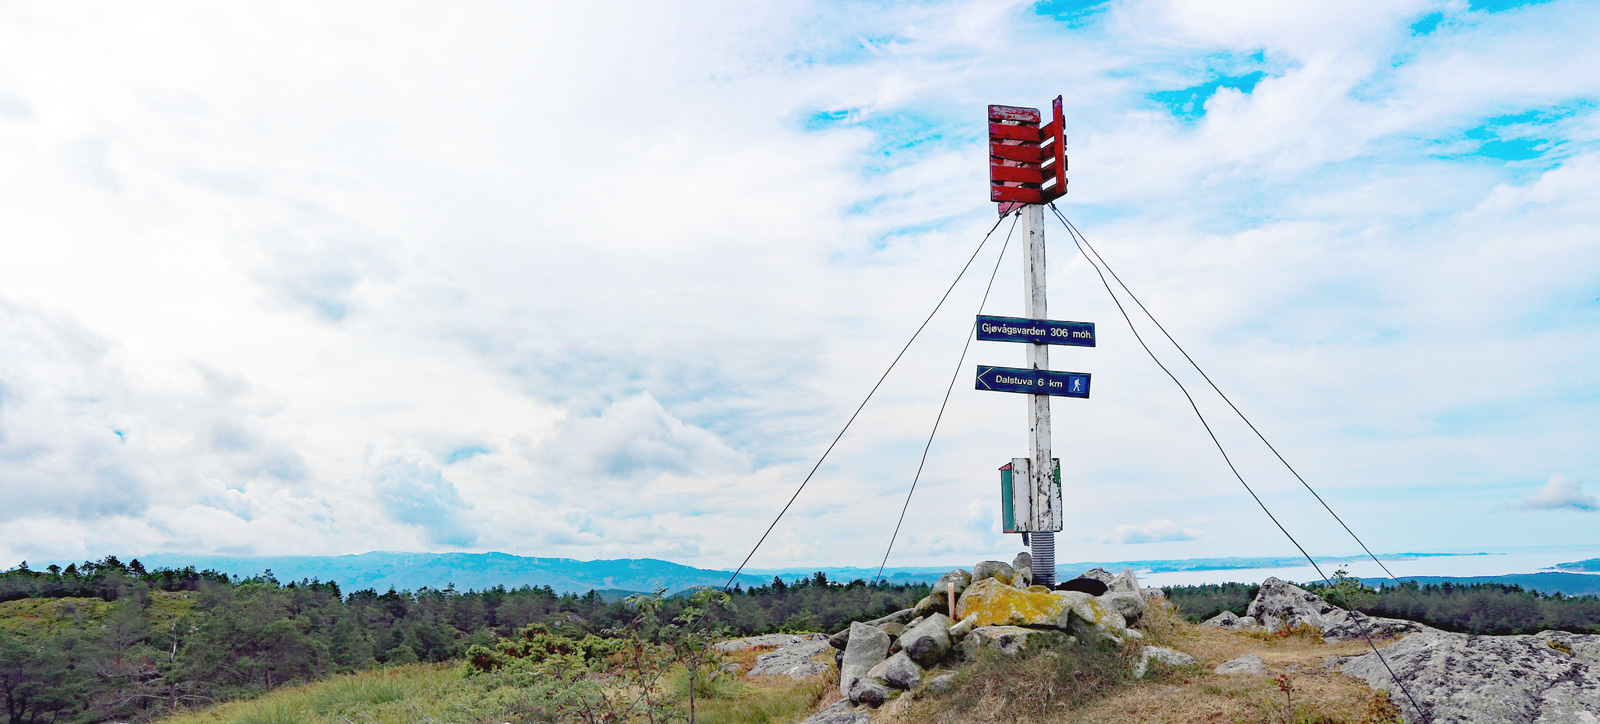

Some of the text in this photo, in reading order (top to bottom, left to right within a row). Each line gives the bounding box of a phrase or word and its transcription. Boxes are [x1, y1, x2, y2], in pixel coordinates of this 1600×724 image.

[981, 323, 1046, 336] Gjøvågsvarden
[1050, 327, 1068, 338] 306
[995, 375, 1063, 388] Dalstuva 6 km
